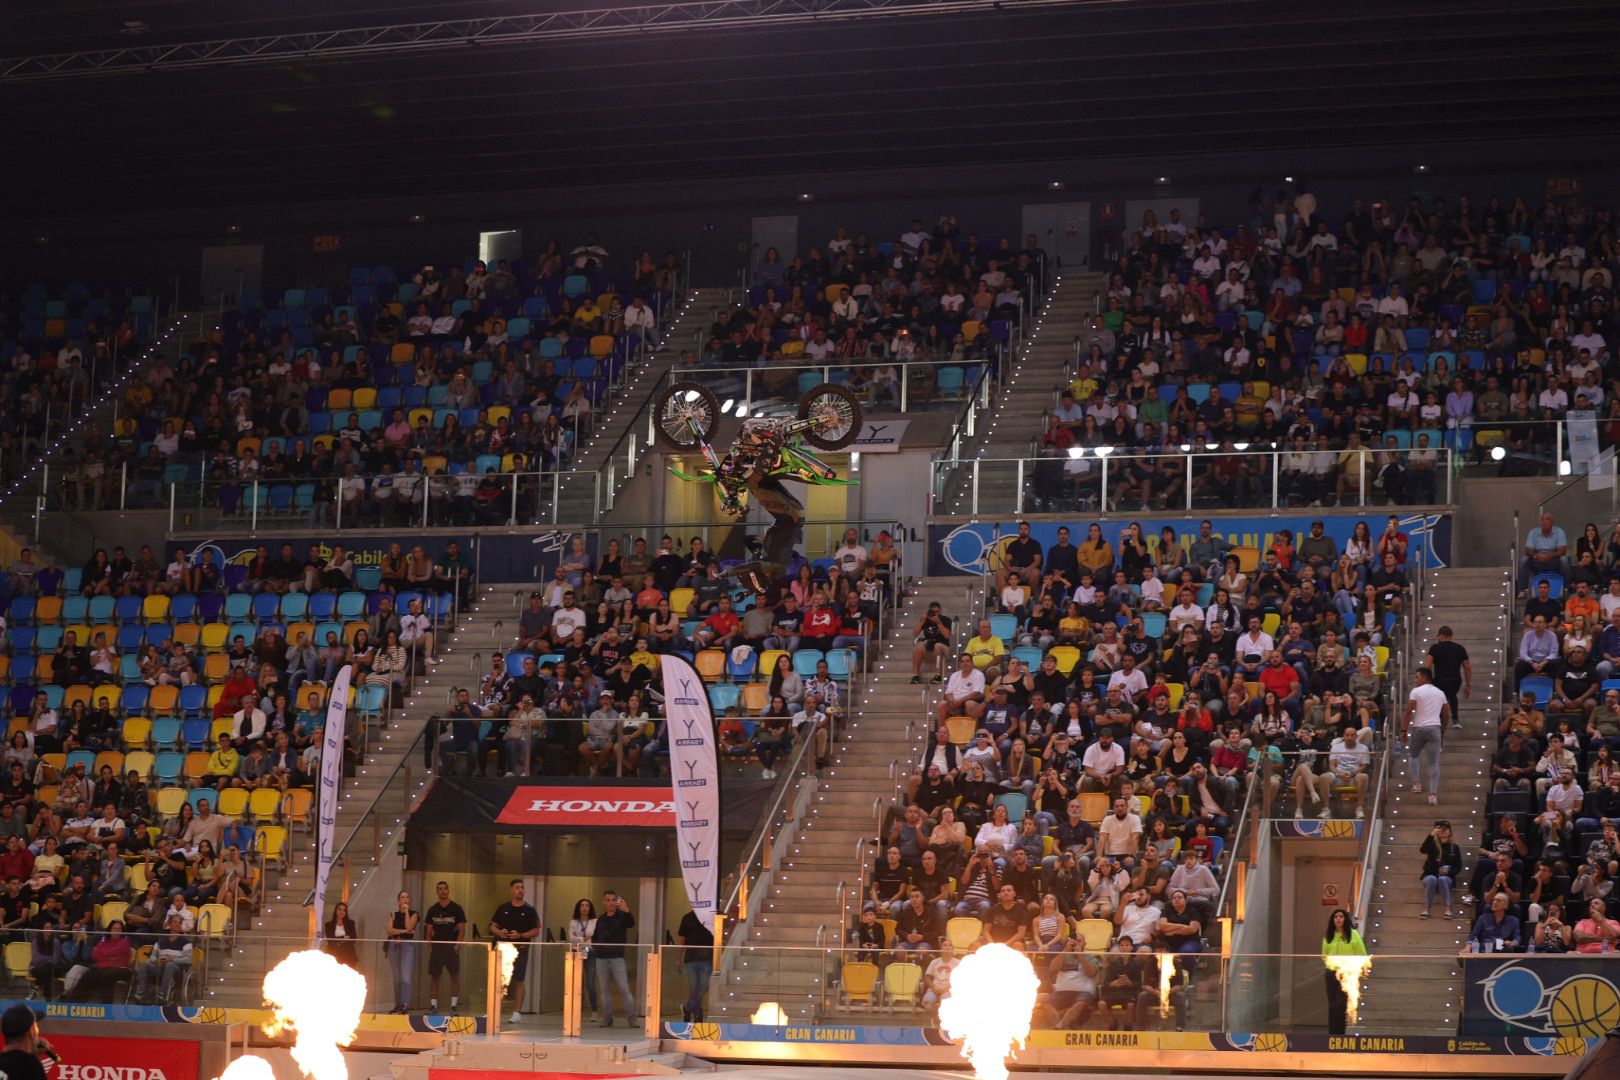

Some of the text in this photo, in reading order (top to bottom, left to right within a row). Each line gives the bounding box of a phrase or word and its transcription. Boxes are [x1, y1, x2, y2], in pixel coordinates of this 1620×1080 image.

[527, 799, 677, 813] HONDA
[46, 1004, 105, 1018] GRAN CANARIA
[785, 1027, 856, 1041] GRAN CANARIA
[1065, 1032, 1138, 1047] GRAN CANARIA
[1328, 1036, 1405, 1051] GRAN CANARIA
[57, 1064, 167, 1080] HONDA
